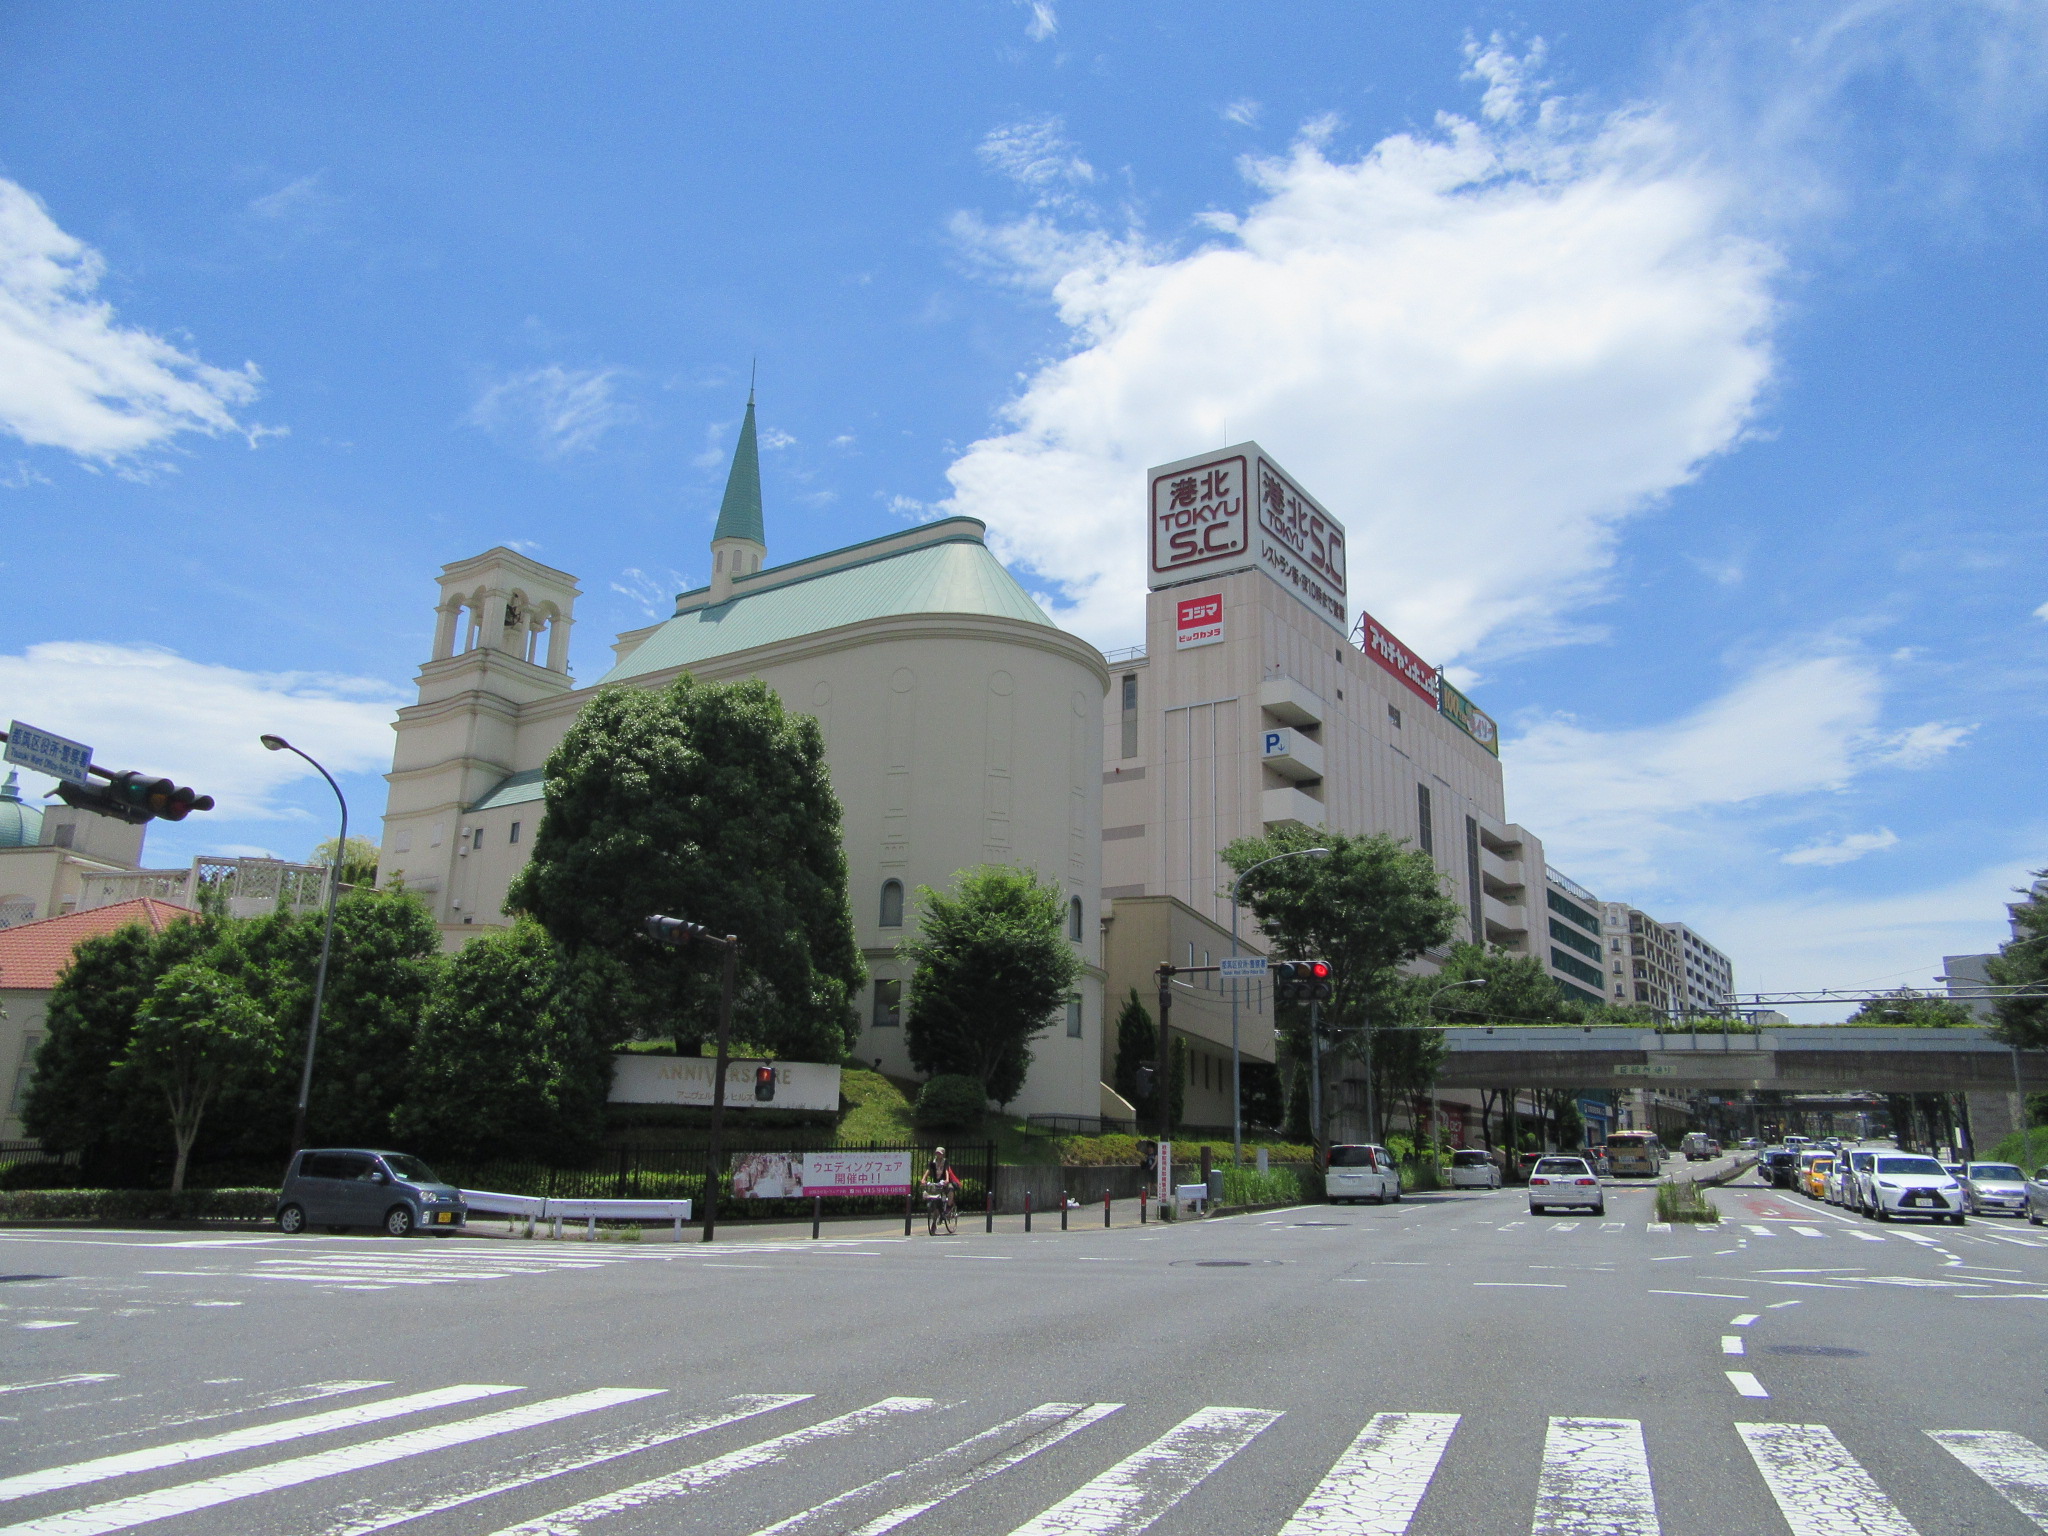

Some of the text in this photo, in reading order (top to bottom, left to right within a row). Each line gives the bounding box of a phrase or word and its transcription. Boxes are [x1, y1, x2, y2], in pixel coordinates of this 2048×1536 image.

[1169, 469, 1230, 510] 港北
[1262, 471, 1309, 537] 港北
[1160, 497, 1241, 532] TOKYU
[1266, 508, 1305, 552] TOKYU
[1169, 521, 1238, 562] S.C.
[1181, 603, 1218, 622] コジマ
[1179, 628, 1221, 643] ビックカメラ
[1266, 733, 1280, 754] P
[813, 1161, 903, 1173] ウエディングフェア
